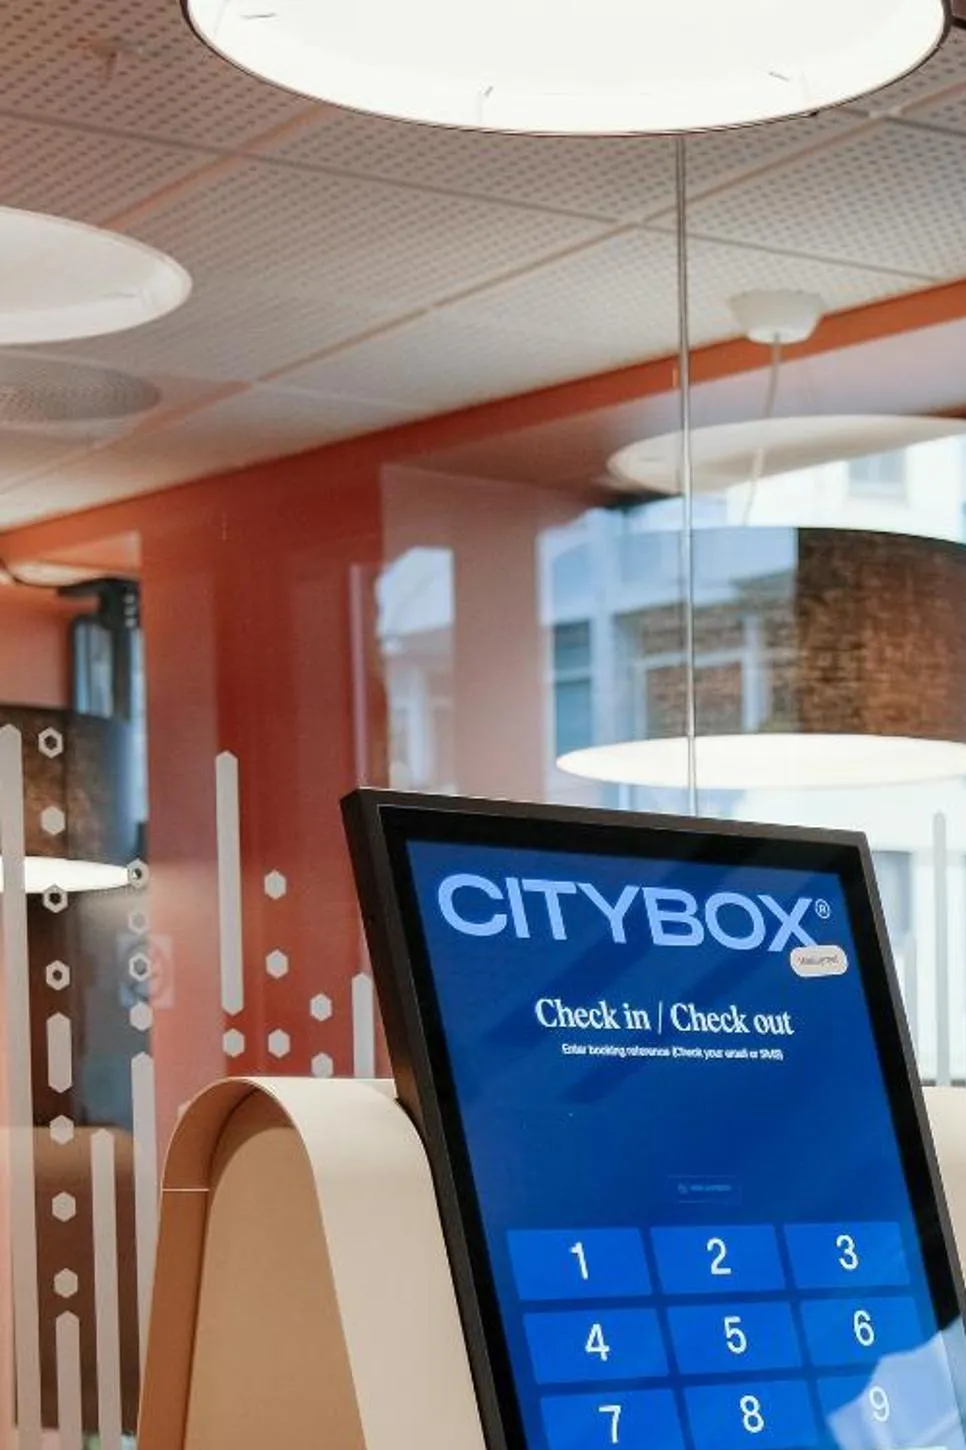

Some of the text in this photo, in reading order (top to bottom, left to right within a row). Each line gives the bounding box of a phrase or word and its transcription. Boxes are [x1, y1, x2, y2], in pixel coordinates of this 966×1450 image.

[535, 998, 620, 1030] Check
[622, 1003, 651, 1030] in
[670, 1003, 751, 1034] Check
[753, 1011, 795, 1036] out
[569, 1234, 859, 1280] 1 2 3
[585, 1310, 875, 1361] 4 5 6
[599, 1386, 890, 1443] 7 8 9
